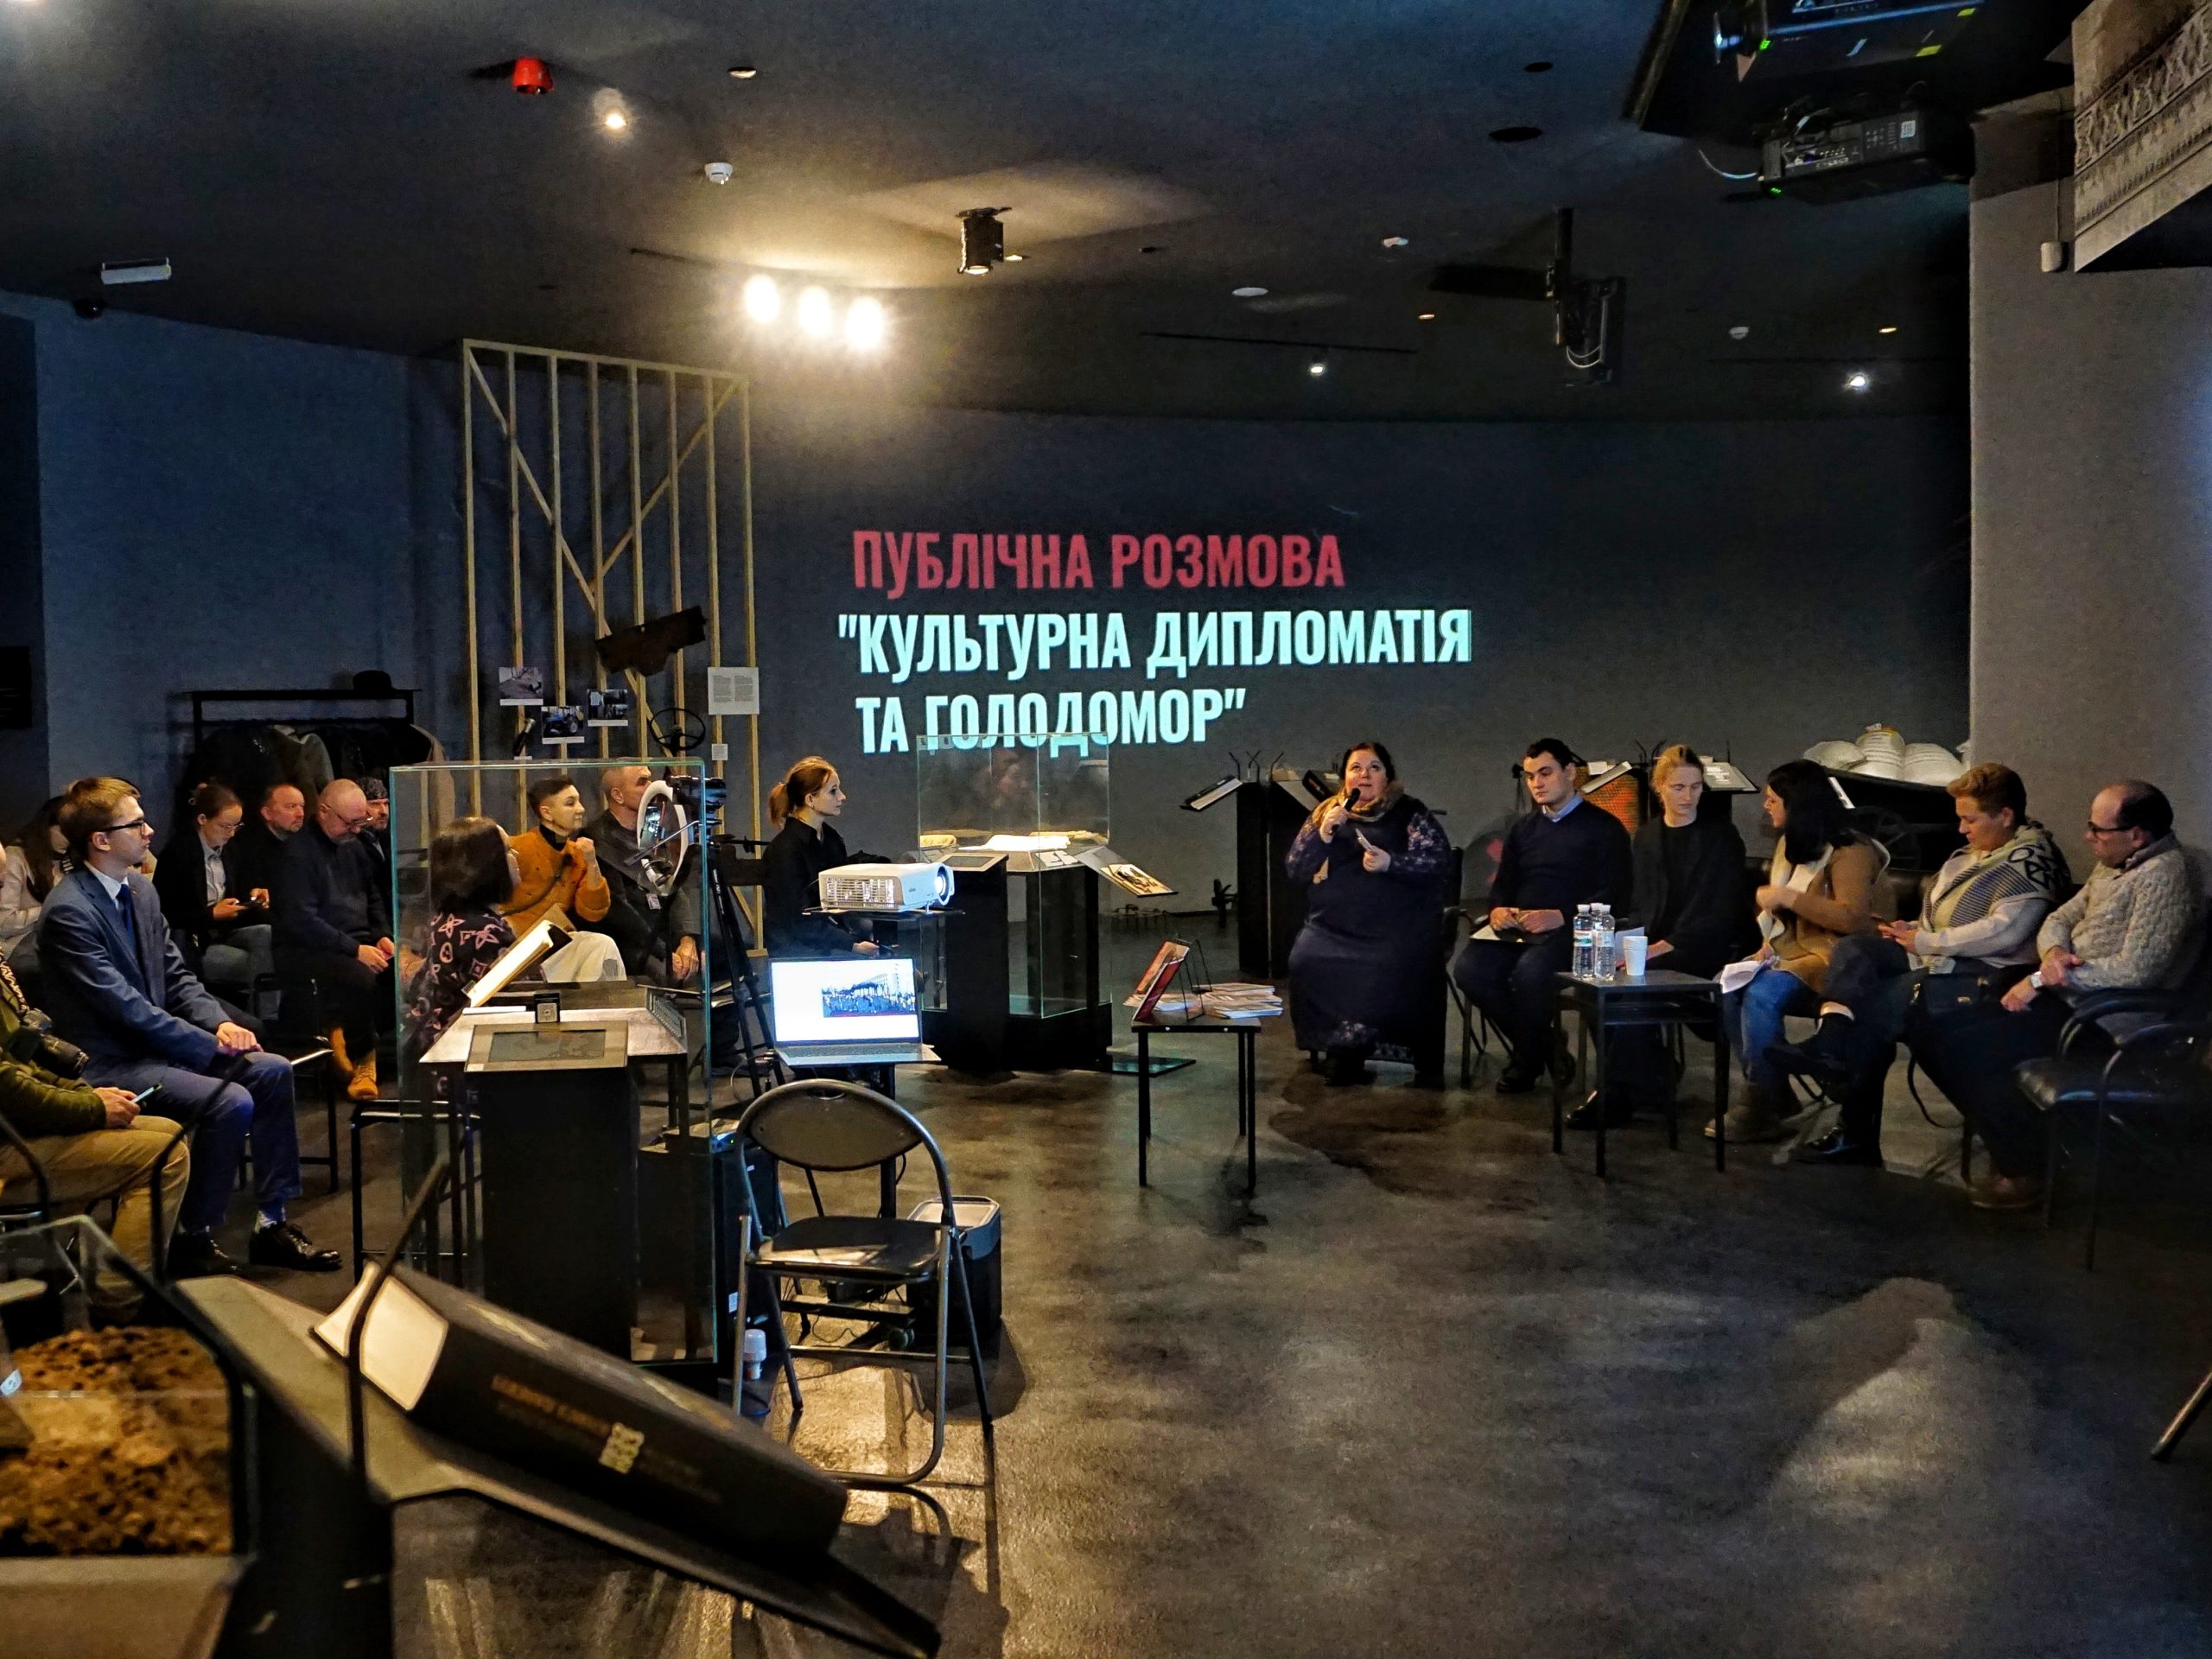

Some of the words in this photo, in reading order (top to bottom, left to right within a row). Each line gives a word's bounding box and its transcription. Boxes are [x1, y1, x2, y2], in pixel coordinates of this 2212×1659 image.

[853, 530, 1093, 599] ПУБЛІЧНА
[1110, 534, 1344, 588] РОЗМОВА
[838, 612, 1132, 683] "КУЛЬТУРНА
[1146, 608, 1472, 679] ДИПЛОМАТІЯ
[855, 696, 910, 753] ТА
[925, 688, 1247, 759] ГОЛОДОМОР"
